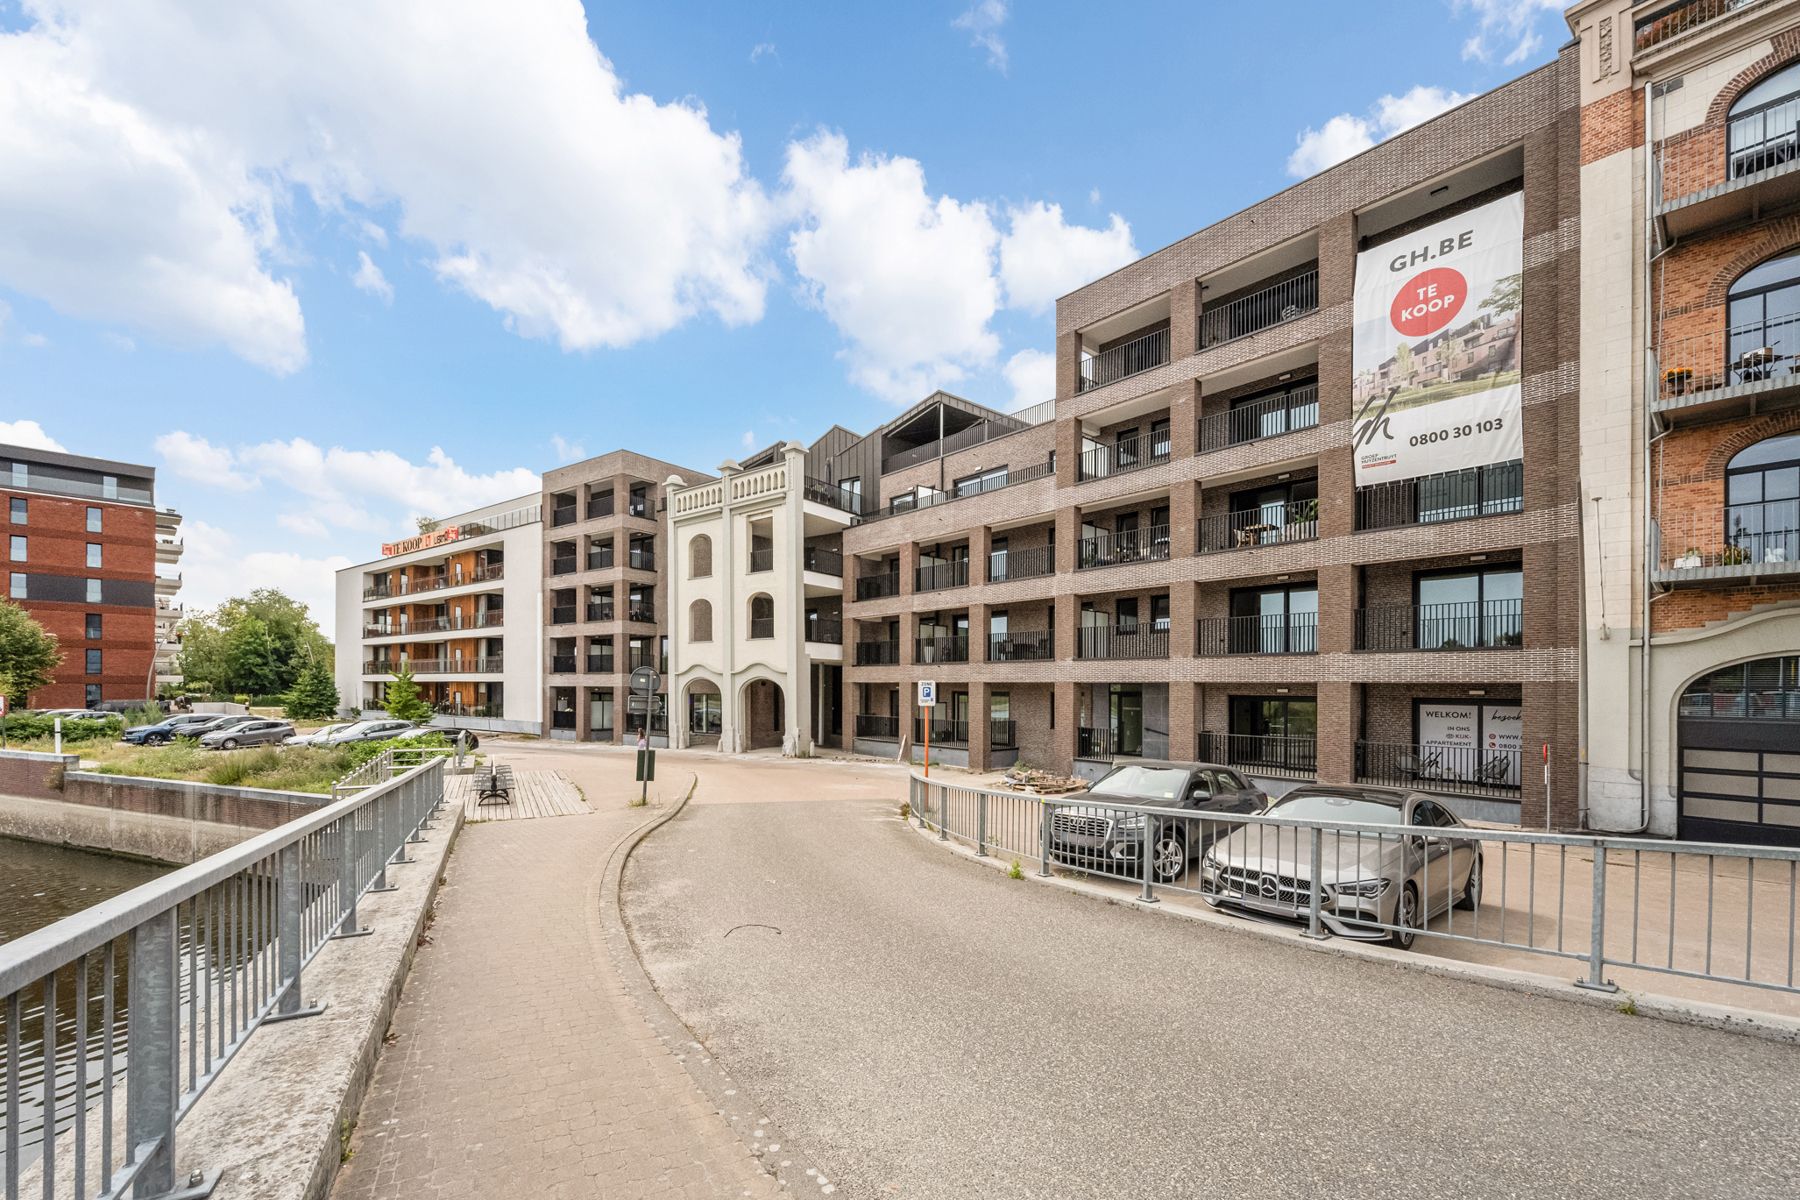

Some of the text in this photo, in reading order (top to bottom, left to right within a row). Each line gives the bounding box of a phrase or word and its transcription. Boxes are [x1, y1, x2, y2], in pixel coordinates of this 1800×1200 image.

[1389, 229, 1473, 272] GH.BE
[1417, 283, 1438, 300] TE
[1401, 294, 1454, 321] KOOP
[1409, 418, 1504, 447] 0800 30 103
[402, 538, 422, 552] KOOP
[1425, 711, 1472, 719] WELKOM!
